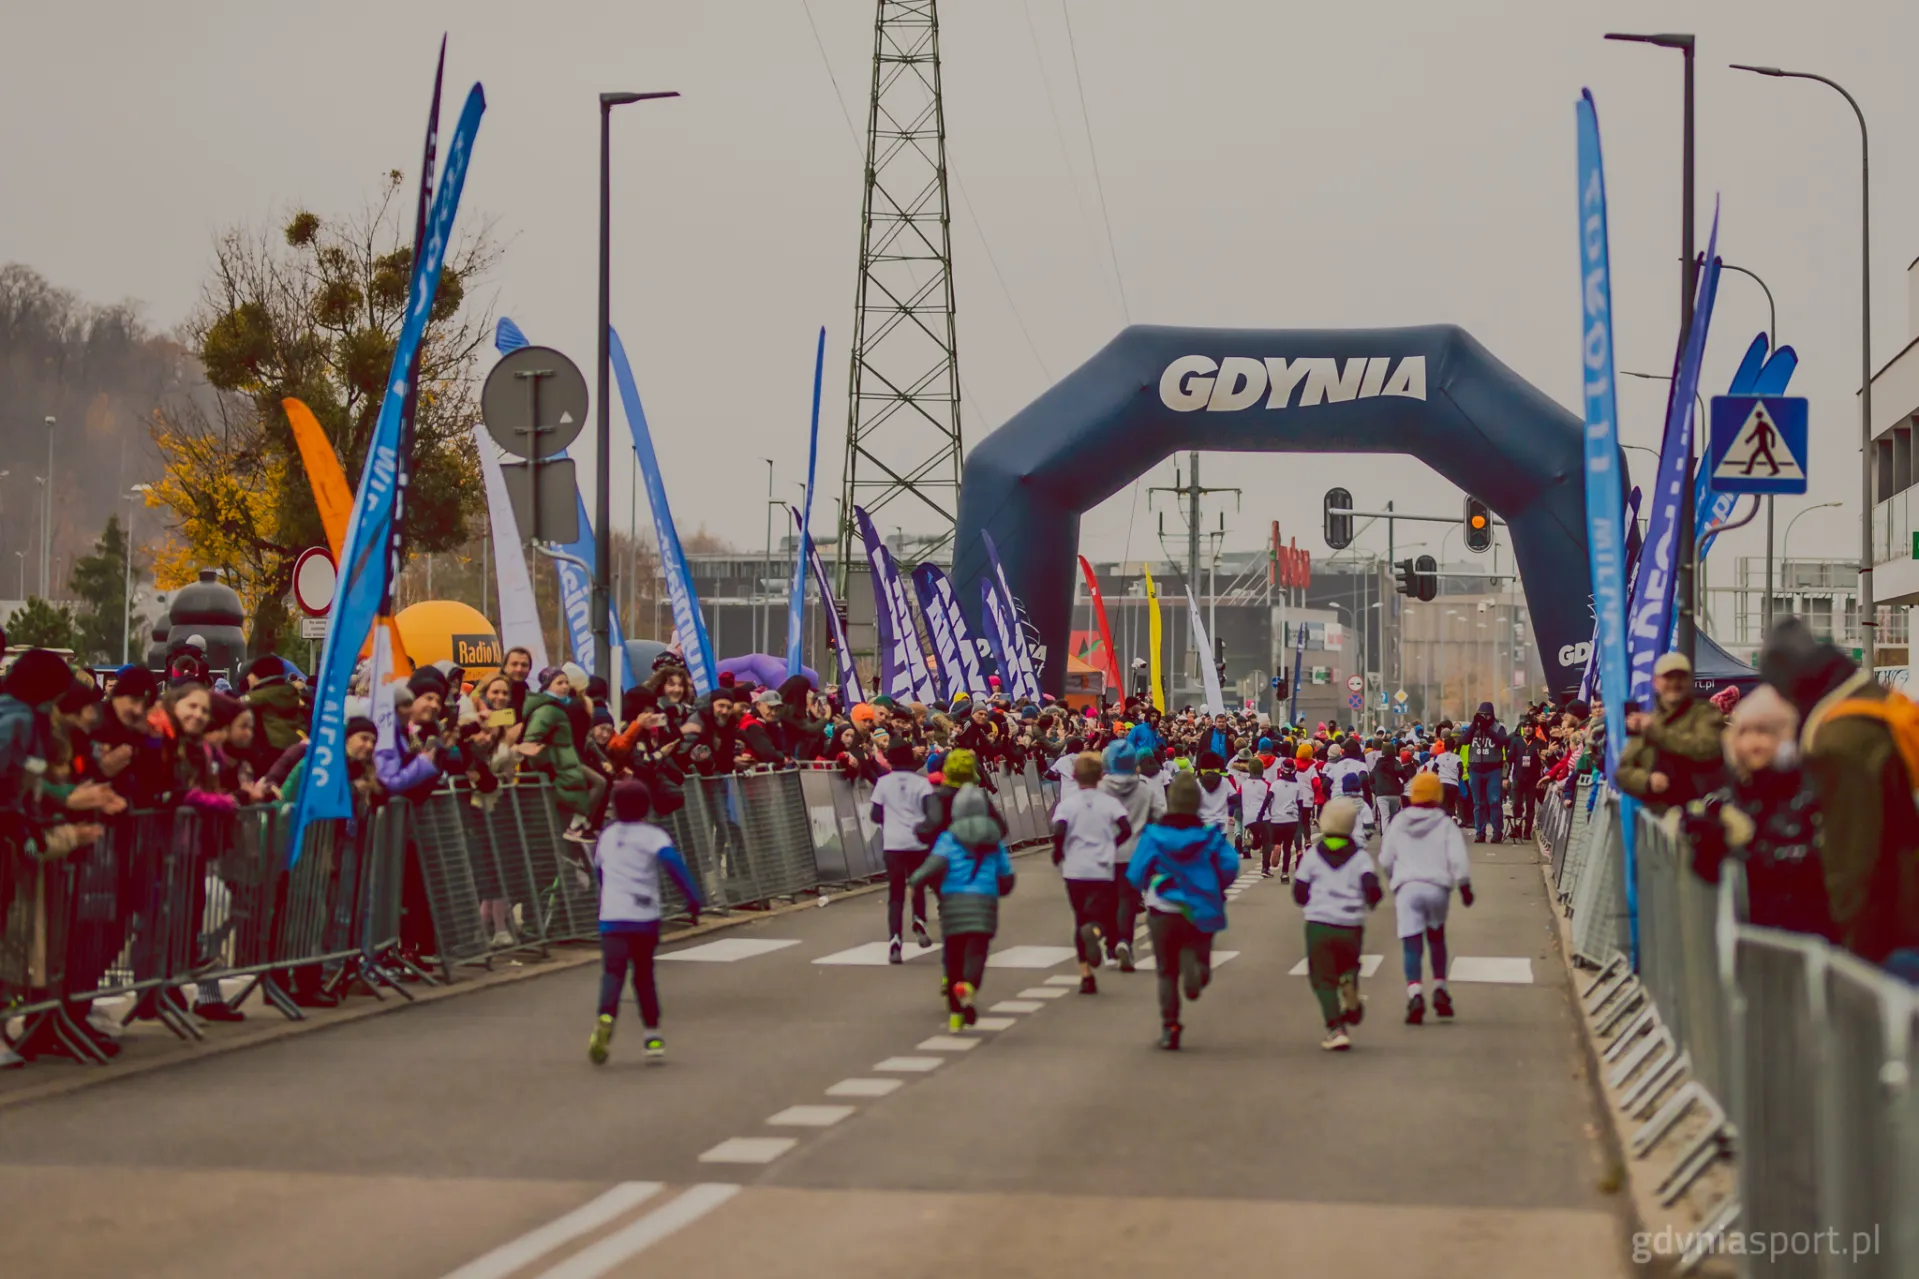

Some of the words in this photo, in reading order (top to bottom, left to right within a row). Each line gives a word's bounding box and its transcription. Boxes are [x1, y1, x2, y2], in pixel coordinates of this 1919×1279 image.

[1158, 354, 1427, 412] GDYNIA
[459, 640, 492, 664] Radio
[1694, 679, 1715, 691] rt.pl
